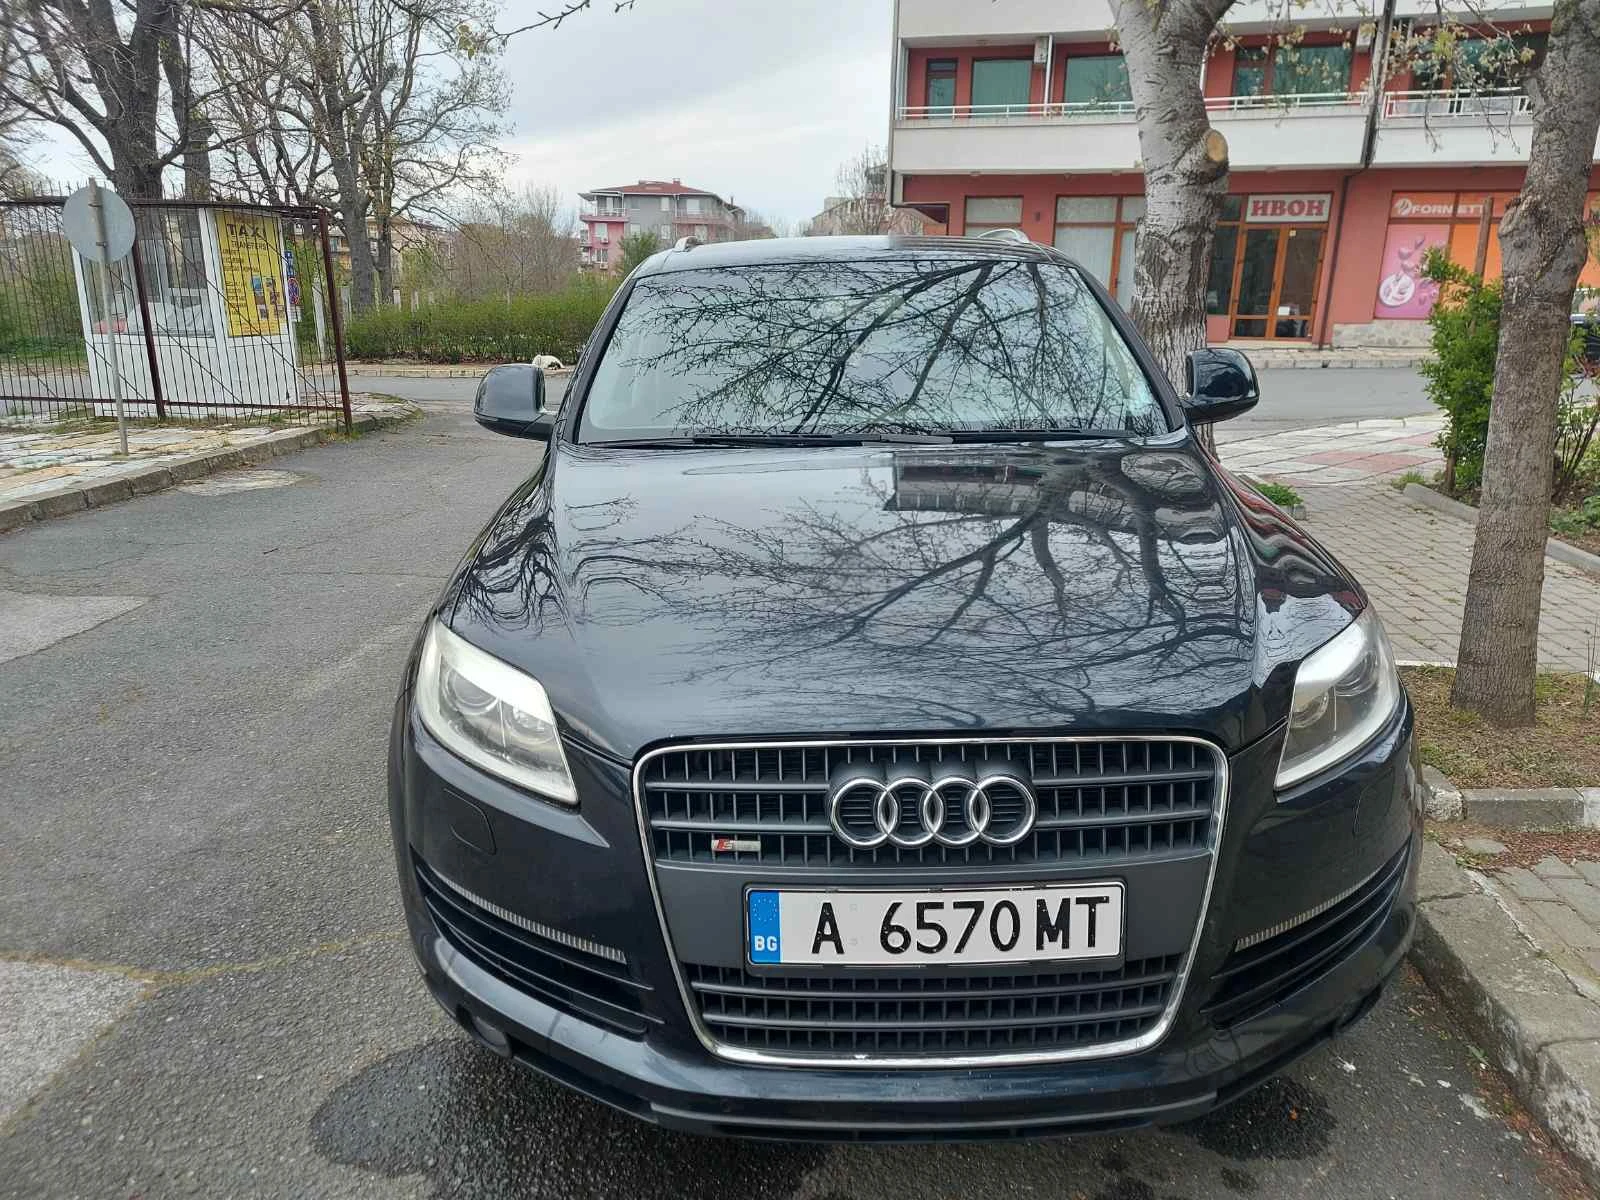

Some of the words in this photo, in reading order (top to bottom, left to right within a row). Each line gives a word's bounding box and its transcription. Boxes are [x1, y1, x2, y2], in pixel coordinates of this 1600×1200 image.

[1251, 199, 1325, 216] ИВОН
[811, 902, 845, 955] A
[879, 899, 1021, 954] 6570
[1036, 895, 1110, 951] MT
[754, 935, 778, 951] BG
